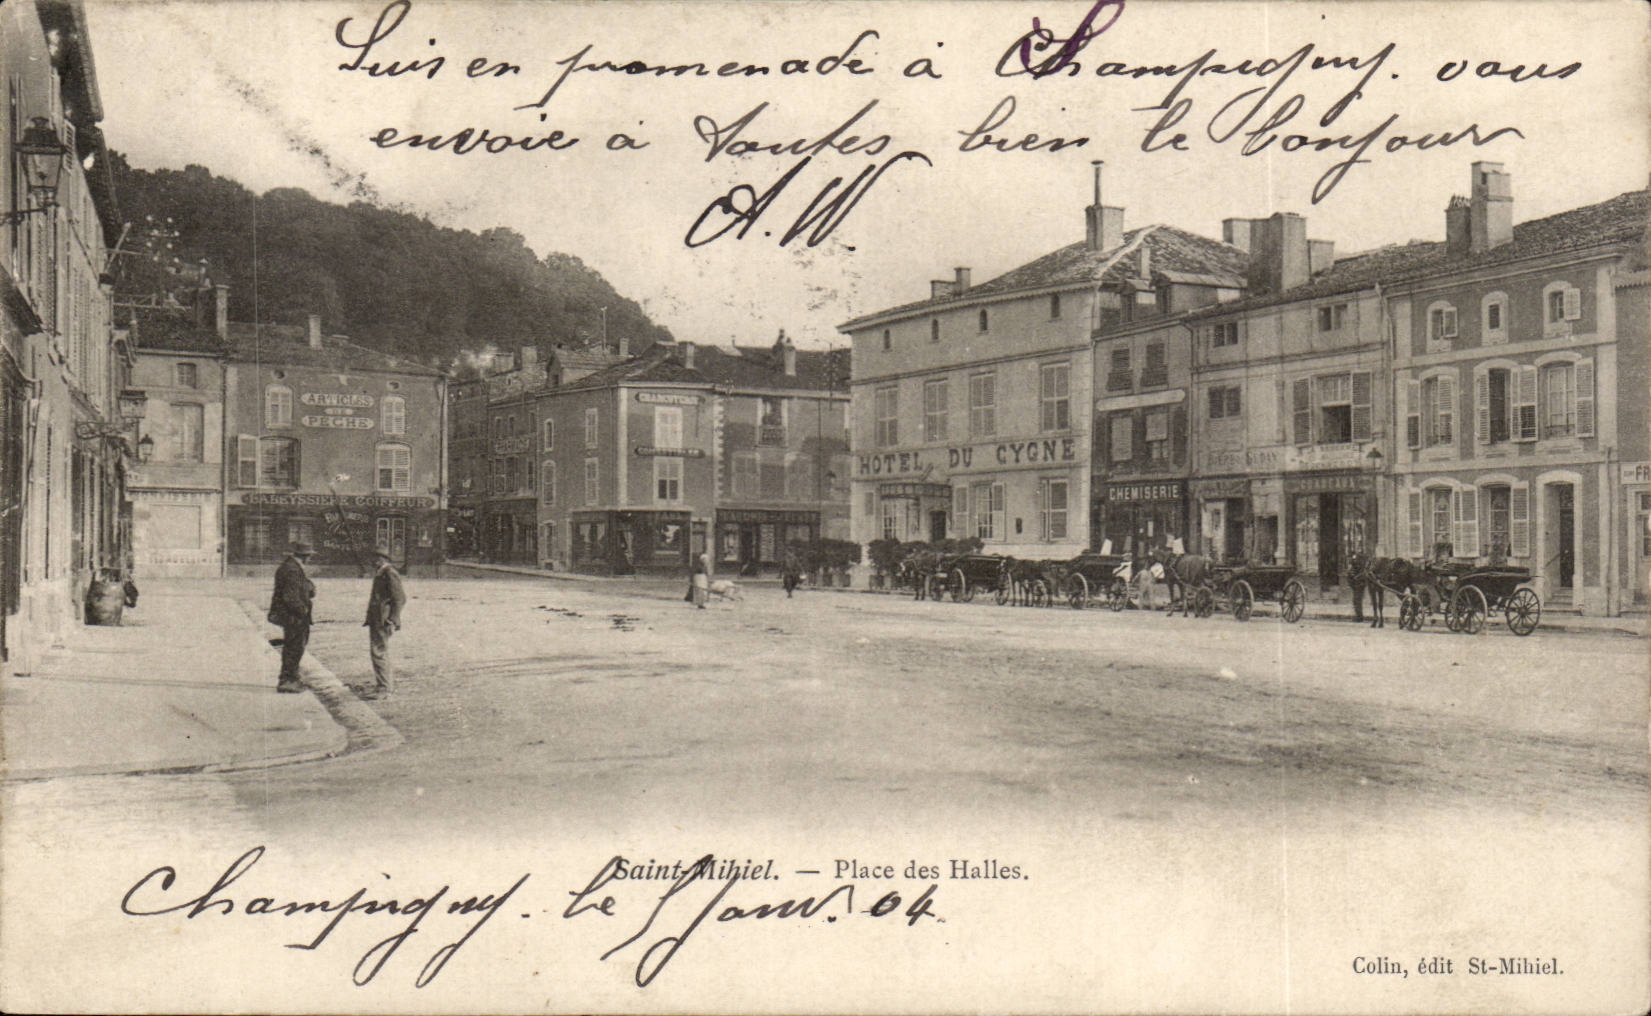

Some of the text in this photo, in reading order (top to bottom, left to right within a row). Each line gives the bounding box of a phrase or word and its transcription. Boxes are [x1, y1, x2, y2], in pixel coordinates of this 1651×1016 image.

[465, 55, 522, 78] en
[513, 30, 879, 110] promenade
[903, 41, 944, 79] à
[1436, 59, 1584, 82] vous
[370, 112, 581, 155] envoie
[957, 95, 1092, 154] bien
[1140, 97, 1191, 153] le
[1207, 87, 1527, 205] bonjour
[308, 394, 369, 407] ARTICLES
[859, 439, 1076, 475] HOTEL DU CYGNE
[354, 495, 428, 507] COIFFEUR
[1109, 484, 1180, 500] CHEMISERIE
